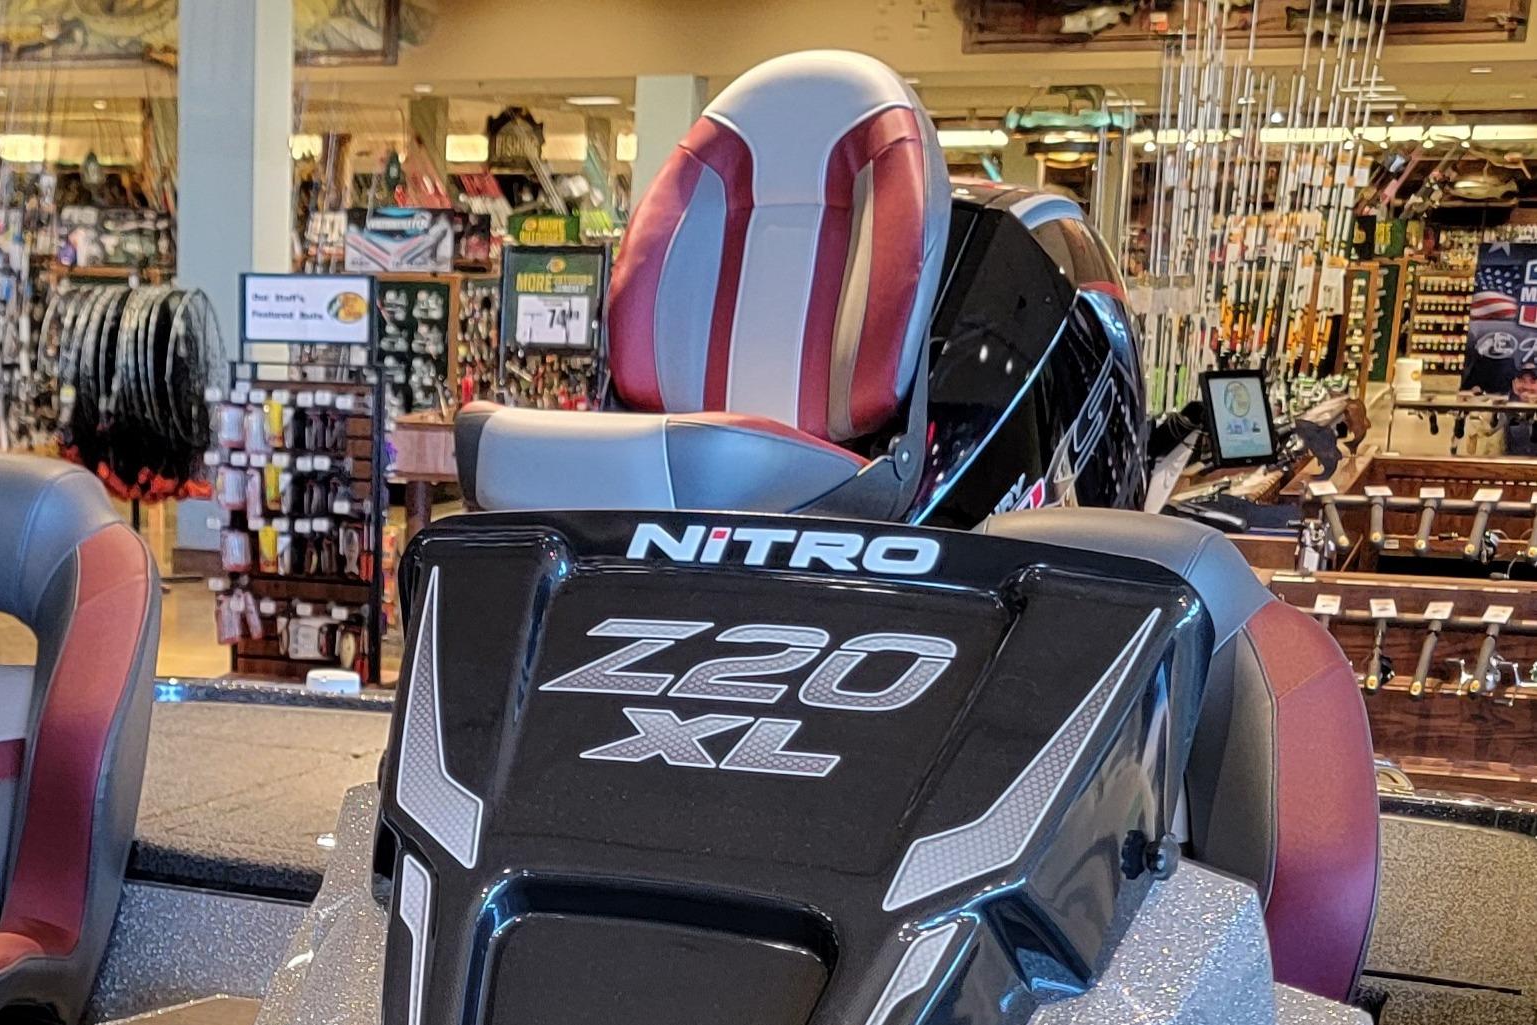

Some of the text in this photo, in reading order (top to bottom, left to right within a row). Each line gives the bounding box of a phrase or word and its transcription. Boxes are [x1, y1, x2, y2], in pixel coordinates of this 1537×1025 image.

[516, 272, 552, 293] MORE
[538, 618, 959, 713] Z20
[579, 706, 842, 778] XL
